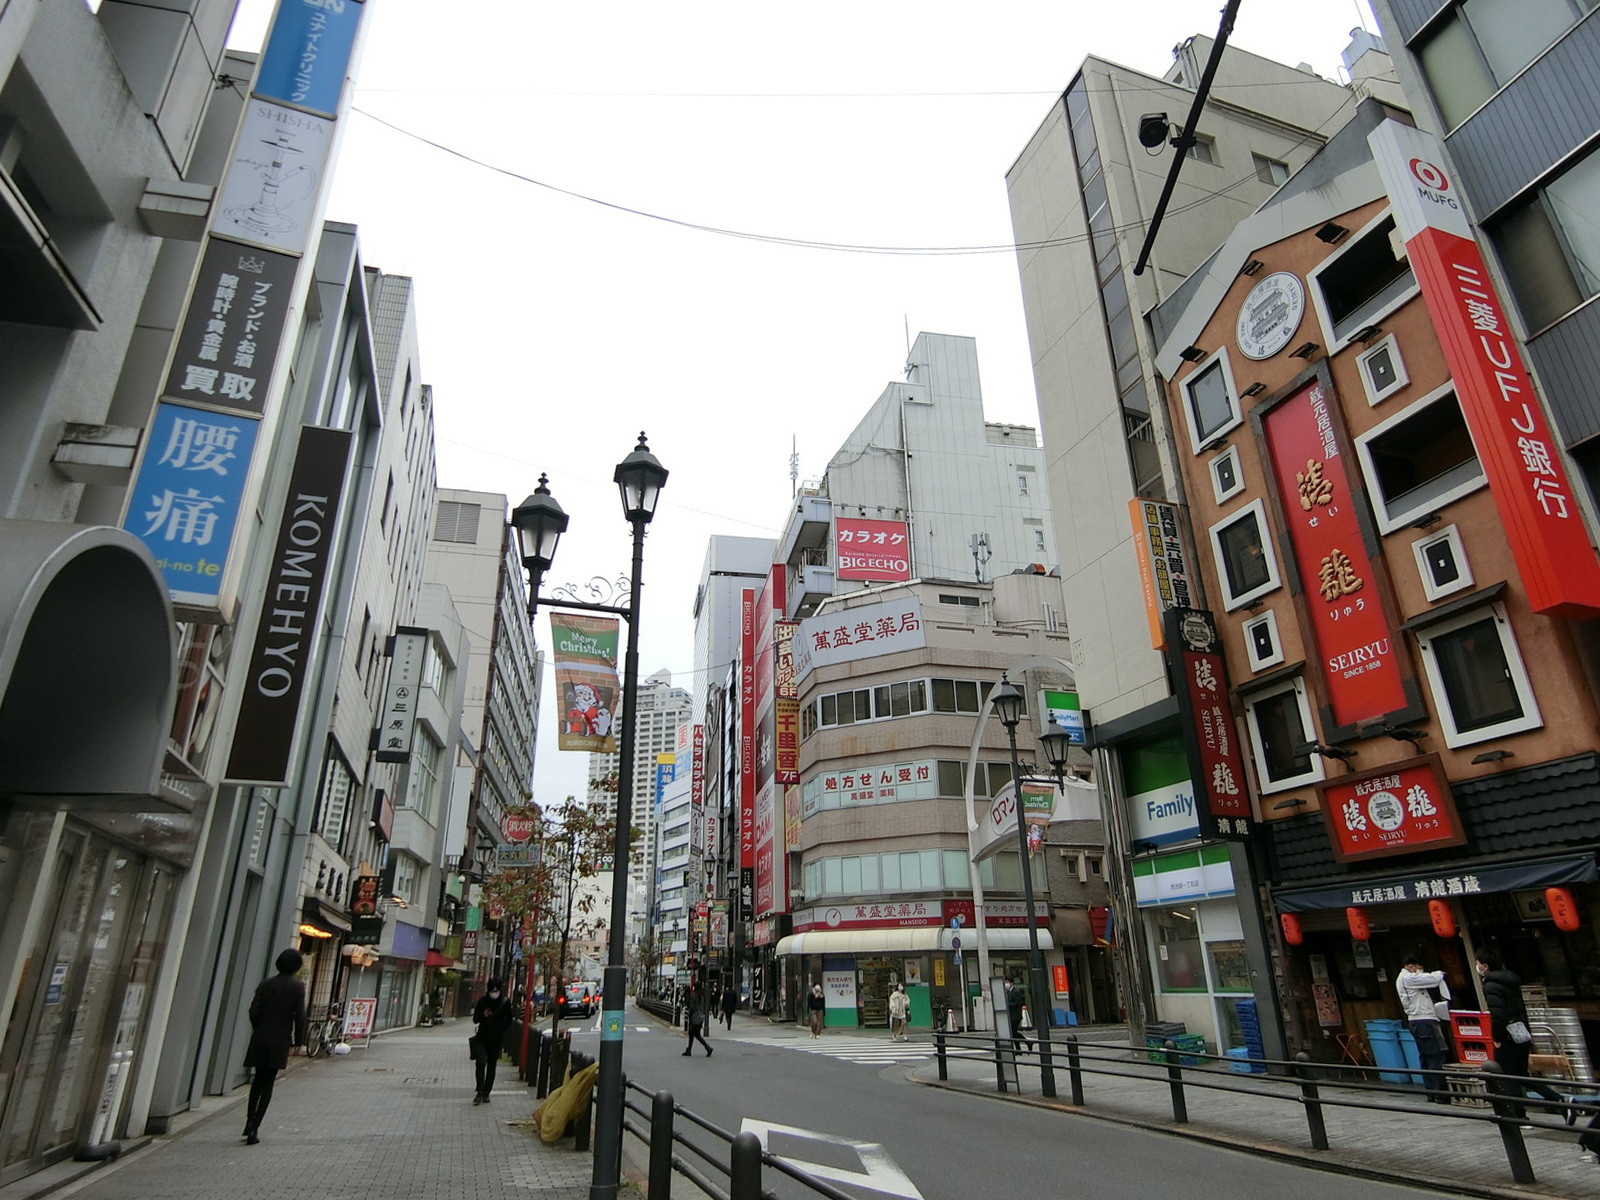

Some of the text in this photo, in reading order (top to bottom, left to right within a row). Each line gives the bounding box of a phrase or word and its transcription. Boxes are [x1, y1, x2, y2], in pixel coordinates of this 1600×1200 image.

[257, 107, 324, 134] SHISHA
[1416, 186, 1459, 210] MUFG
[198, 272, 239, 362] 腕時計・貴金属
[234, 281, 272, 369] ブランド・お酒
[181, 364, 256, 401] 買取
[141, 416, 241, 547] 腰痛
[1308, 507, 1339, 528] せい
[839, 530, 905, 545] カラオケ
[1148, 525, 1164, 558] 事務所
[839, 556, 908, 572] BIG ECHO
[1319, 547, 1364, 602] 龍
[258, 493, 328, 698] KOMEHYO
[1330, 598, 1365, 621] りゅう
[743, 601, 752, 635] BIG ECHO
[1329, 638, 1389, 673] SEIRYU
[1343, 665, 1364, 679] SINCE
[743, 665, 752, 704] カラオケ
[780, 687, 797, 696] 6F
[387, 702, 407, 749] 三原堂
[778, 714, 797, 769] 千里香
[1201, 709, 1216, 750] SEIRYU
[743, 736, 752, 774] BIG ECHO
[780, 771, 798, 781] 7F
[825, 765, 929, 790] 処方せん受付
[1147, 793, 1194, 821] Family
[707, 817, 715, 851] カラオケ
[743, 808, 752, 852] カラオケ
[1379, 830, 1407, 841] SEIRYU
[1352, 886, 1406, 903] 蔵元居酒屋
